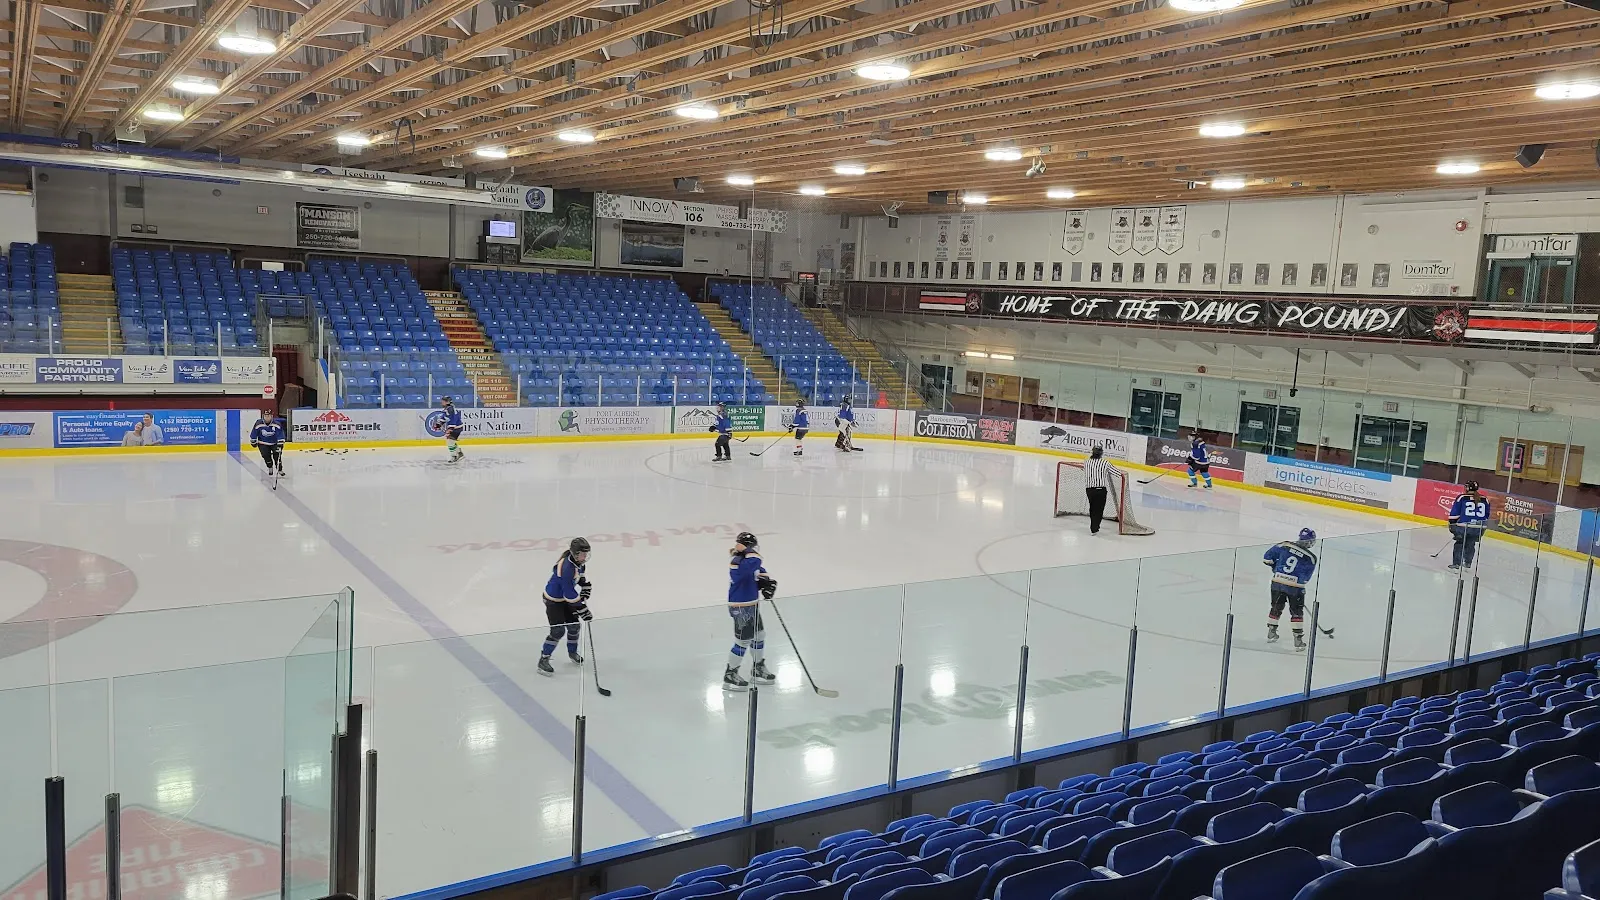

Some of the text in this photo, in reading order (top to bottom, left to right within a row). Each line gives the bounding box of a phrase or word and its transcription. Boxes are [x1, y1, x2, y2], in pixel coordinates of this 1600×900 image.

[685, 213, 703, 222] 106
[1502, 236, 1572, 251] Domtar
[1404, 263, 1452, 275] Domtar
[1000, 295, 1407, 332] HOME OF THE DAWG POUND!
[38, 366, 120, 374] COMMUNITY
[44, 374, 115, 382] PARTNERS
[113, 420, 134, 428] Equity
[464, 421, 521, 431] irst Nation
[584, 417, 650, 425] PHYSIOTHERAPY
[978, 418, 1015, 431] CRASH
[291, 424, 336, 432] eaver
[917, 419, 977, 439] COLLISION
[980, 429, 1009, 442] ZONE
[1062, 433, 1104, 448] ARBUTUS
[1504, 502, 1534, 516] DISTRICT
[1505, 496, 1534, 509] ALBERNI
[1464, 502, 1486, 518] 23
[1496, 511, 1539, 531] LIQUOR
[1283, 556, 1298, 573] 9
